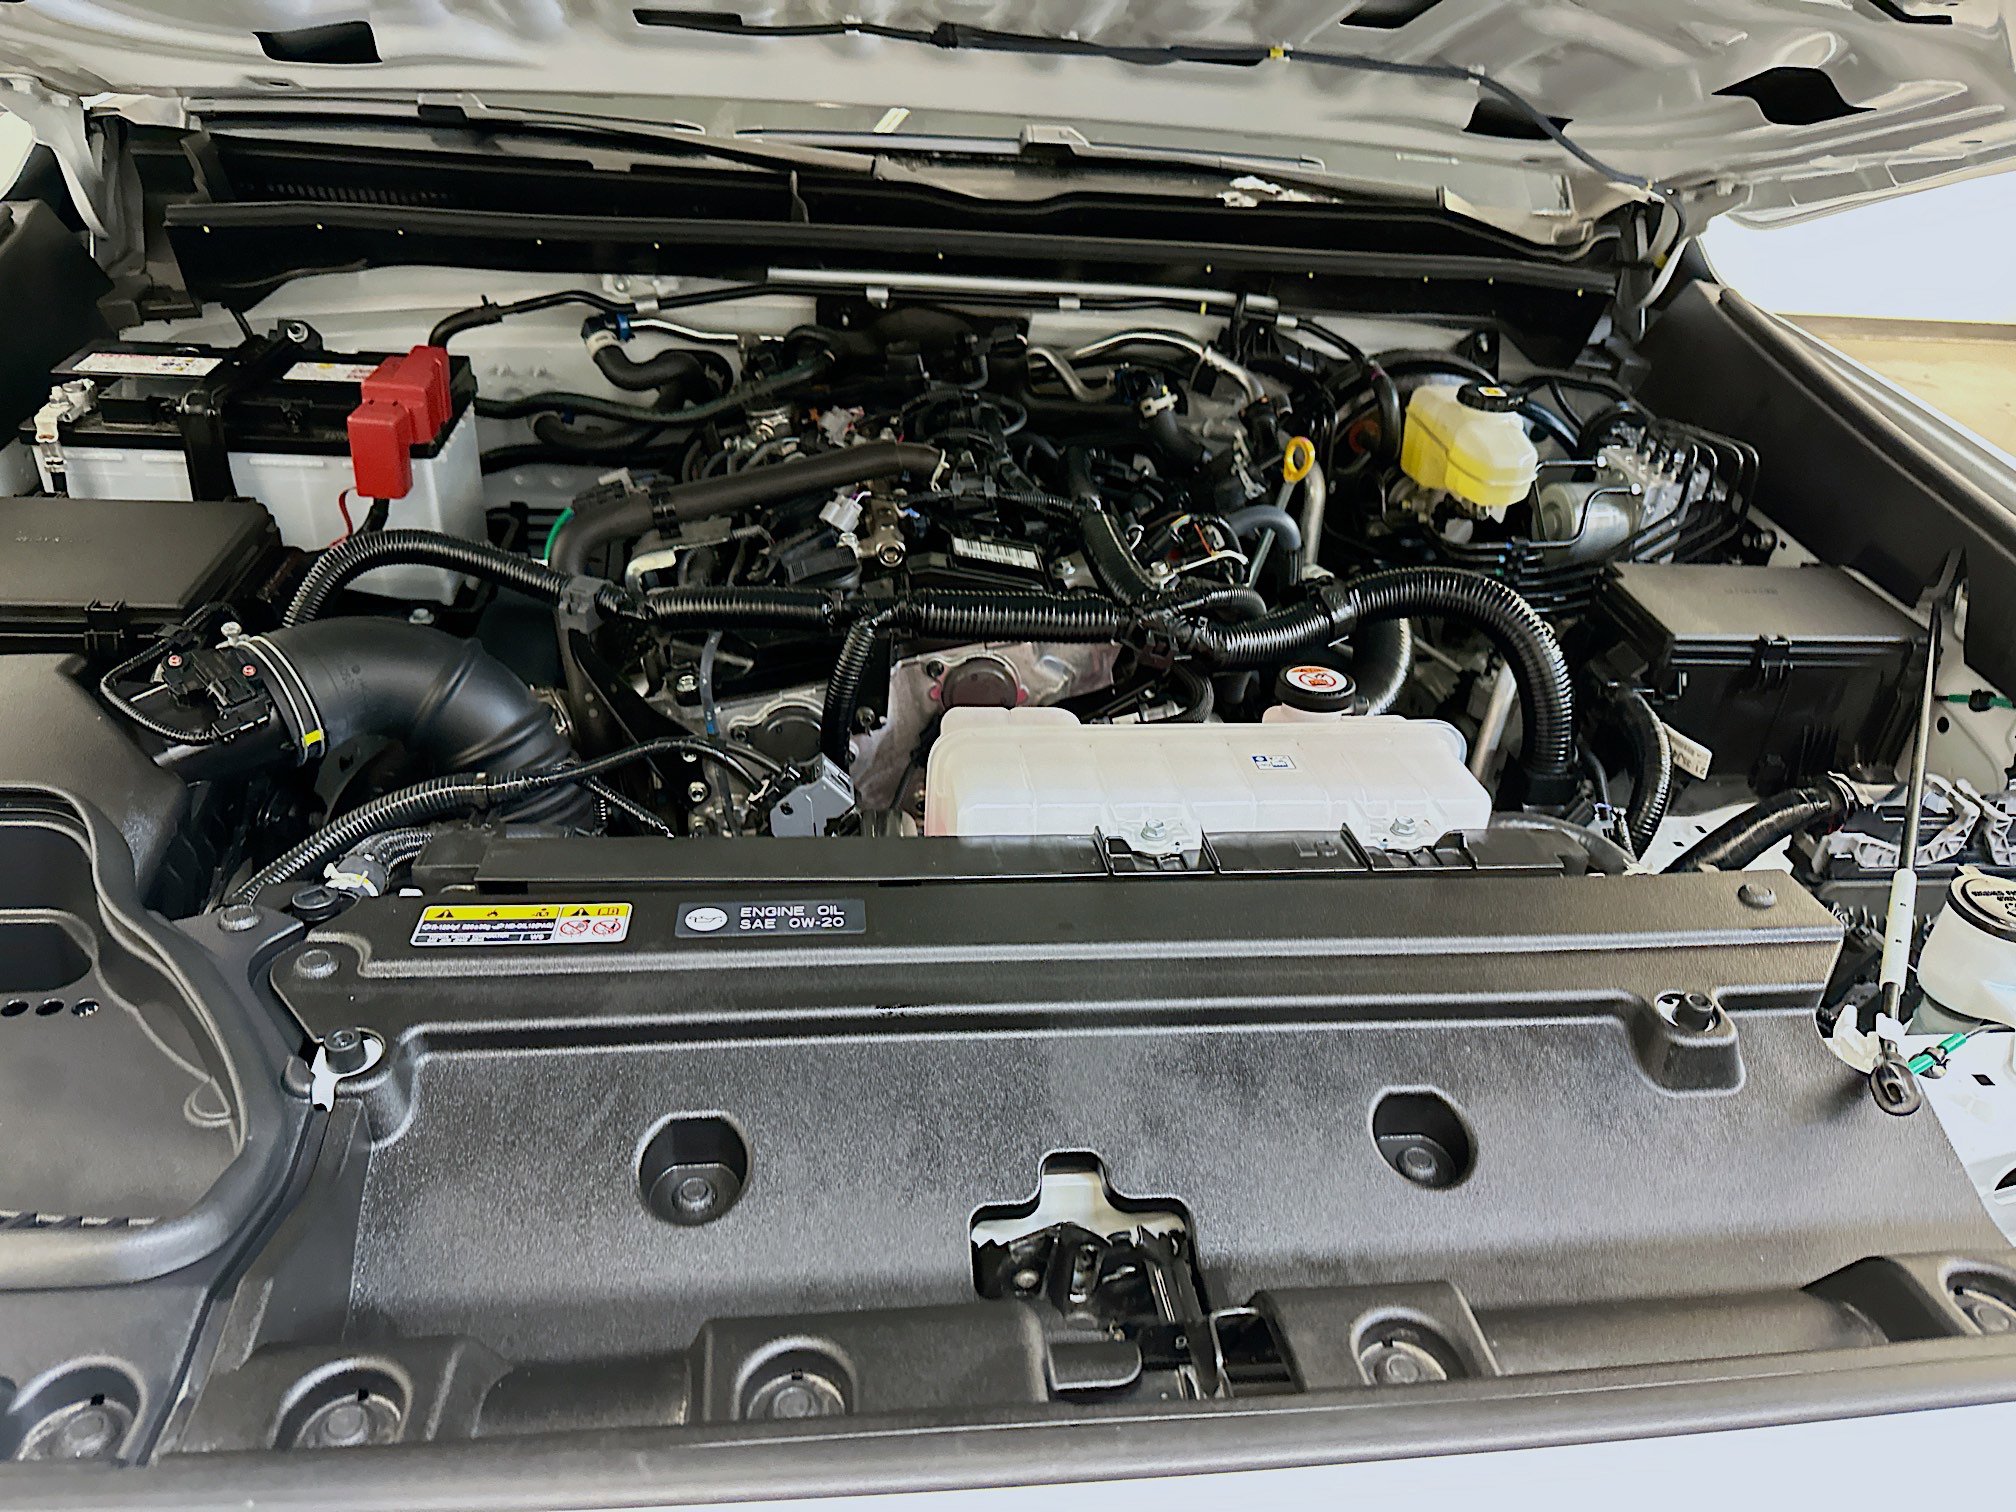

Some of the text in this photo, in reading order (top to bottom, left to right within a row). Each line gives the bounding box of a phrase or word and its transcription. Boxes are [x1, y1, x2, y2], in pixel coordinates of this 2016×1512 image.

[740, 904, 845, 918] ENGINE OIL
[740, 916, 845, 930] SAE 0W-20
